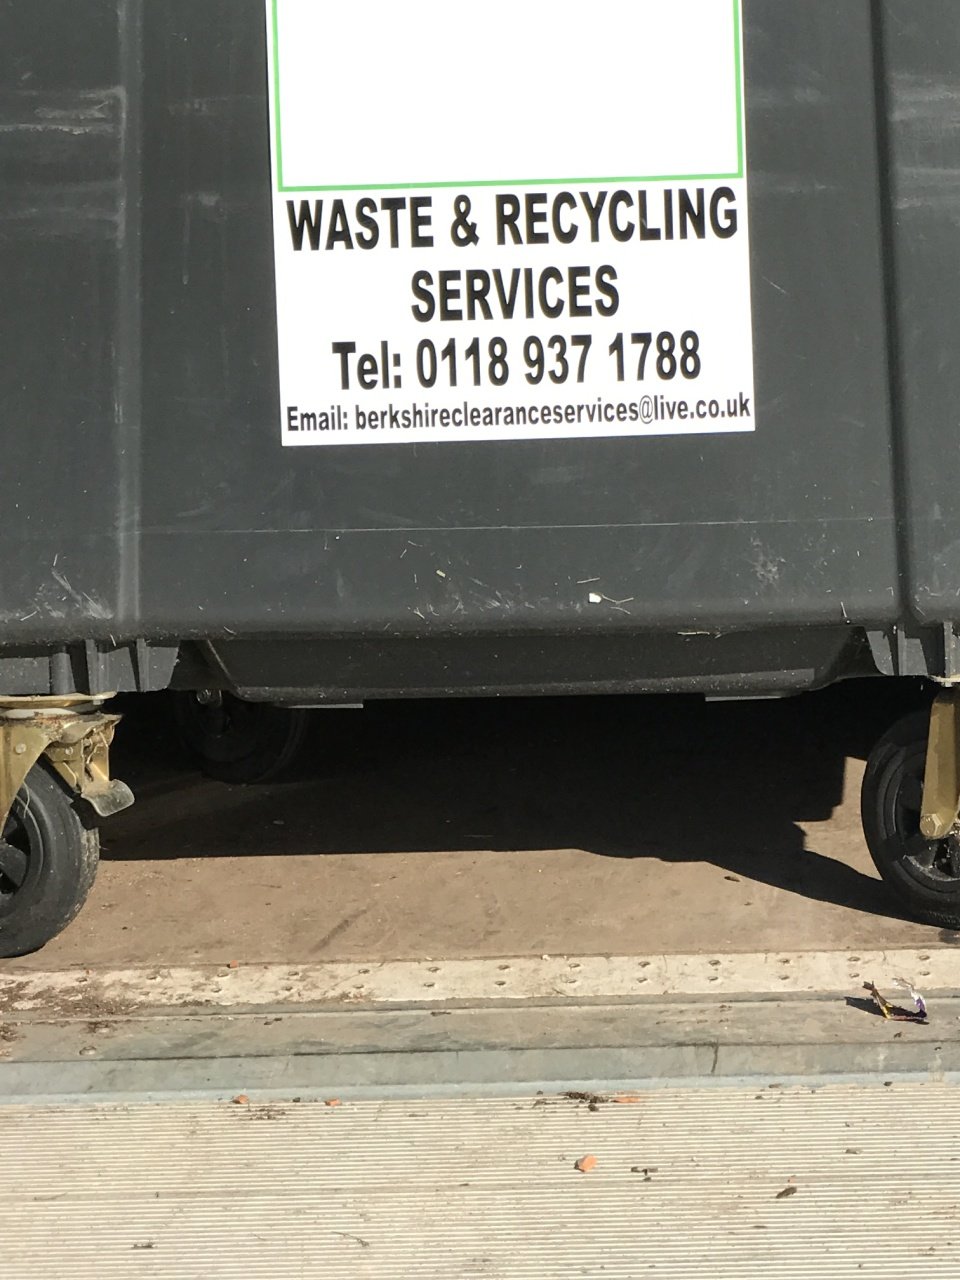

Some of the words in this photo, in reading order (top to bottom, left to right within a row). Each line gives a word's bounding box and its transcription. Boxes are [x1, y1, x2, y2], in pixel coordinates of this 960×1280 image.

[286, 196, 435, 251] WASTE
[450, 194, 481, 248] &
[496, 186, 738, 246] RECYCLING
[410, 264, 620, 322] SERVICES
[332, 340, 401, 391] Tel:
[416, 335, 509, 389] 0118
[523, 334, 593, 385] 937
[608, 329, 701, 383] 1788
[287, 405, 349, 432] Email:
[354, 392, 751, 430] berkshireclearanceservices@live.co.uk
